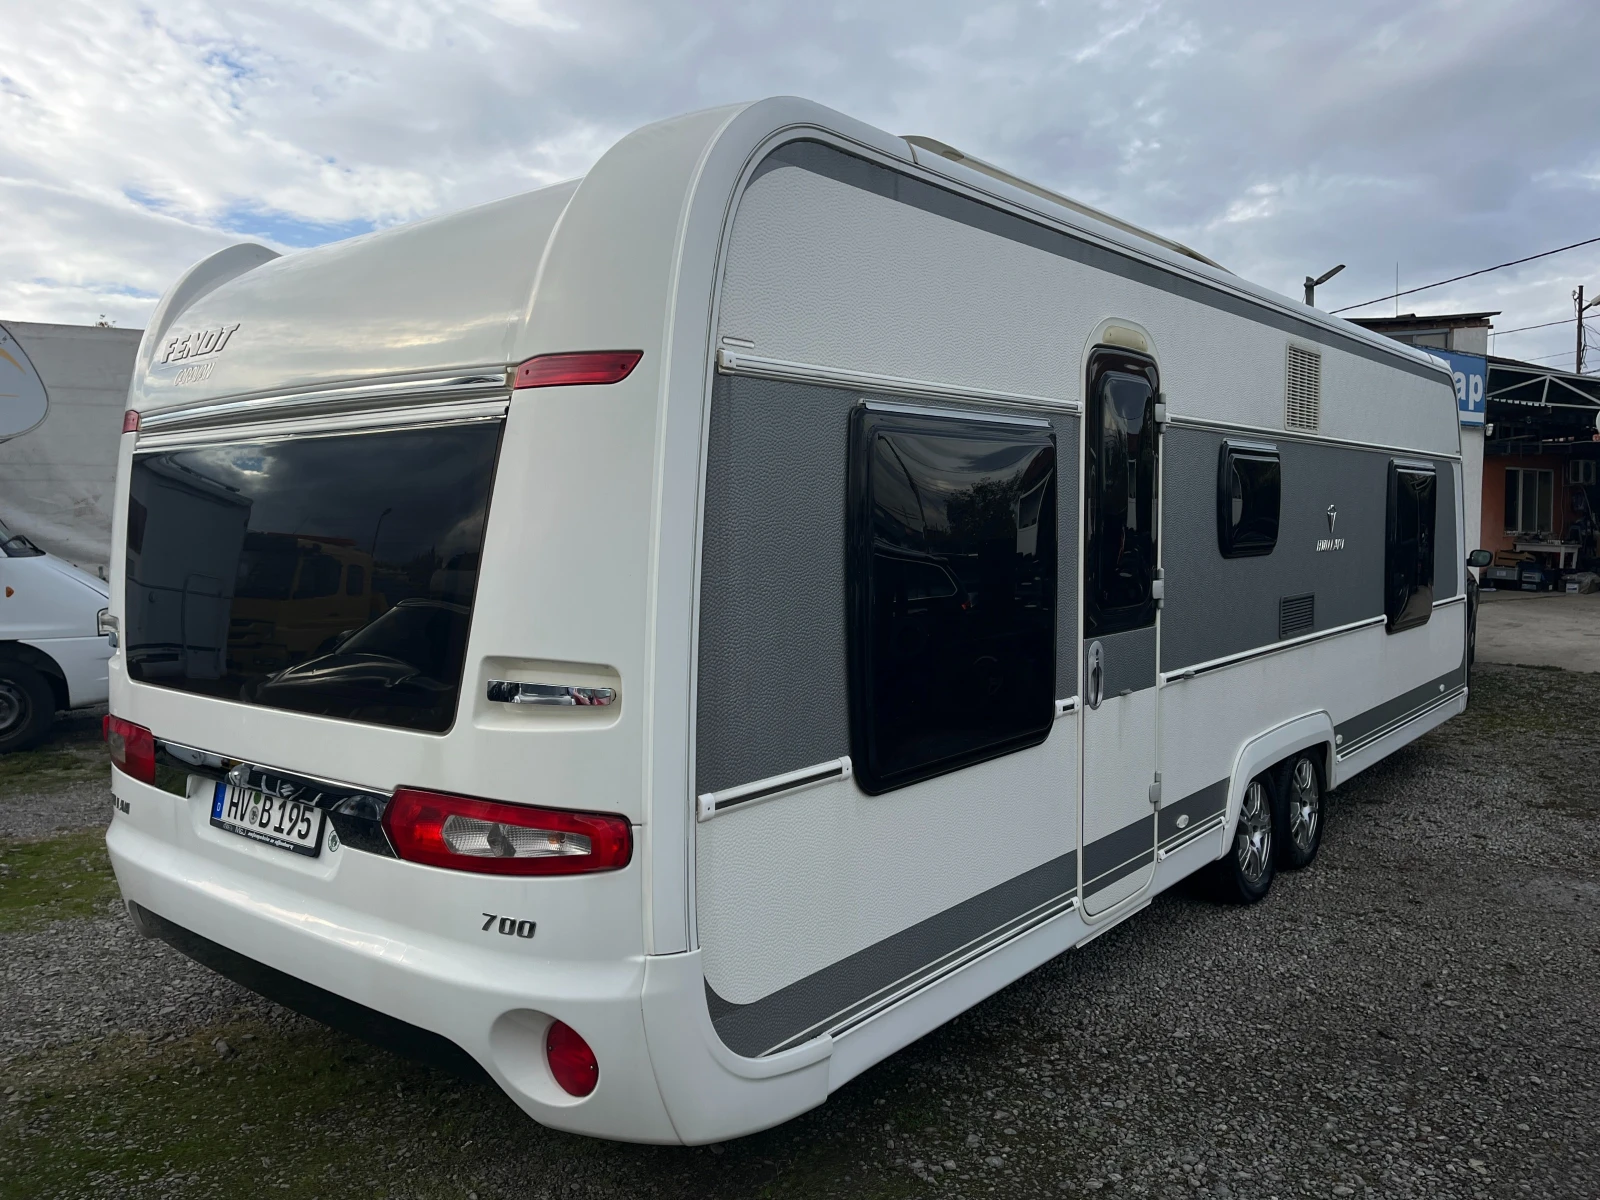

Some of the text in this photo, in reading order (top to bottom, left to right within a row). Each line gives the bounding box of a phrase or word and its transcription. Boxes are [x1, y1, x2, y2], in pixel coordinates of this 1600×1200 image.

[160, 323, 241, 364] FENDT
[227, 786, 254, 822] HV
[258, 795, 274, 829] B
[273, 799, 315, 840] 195
[481, 912, 537, 939] 700
